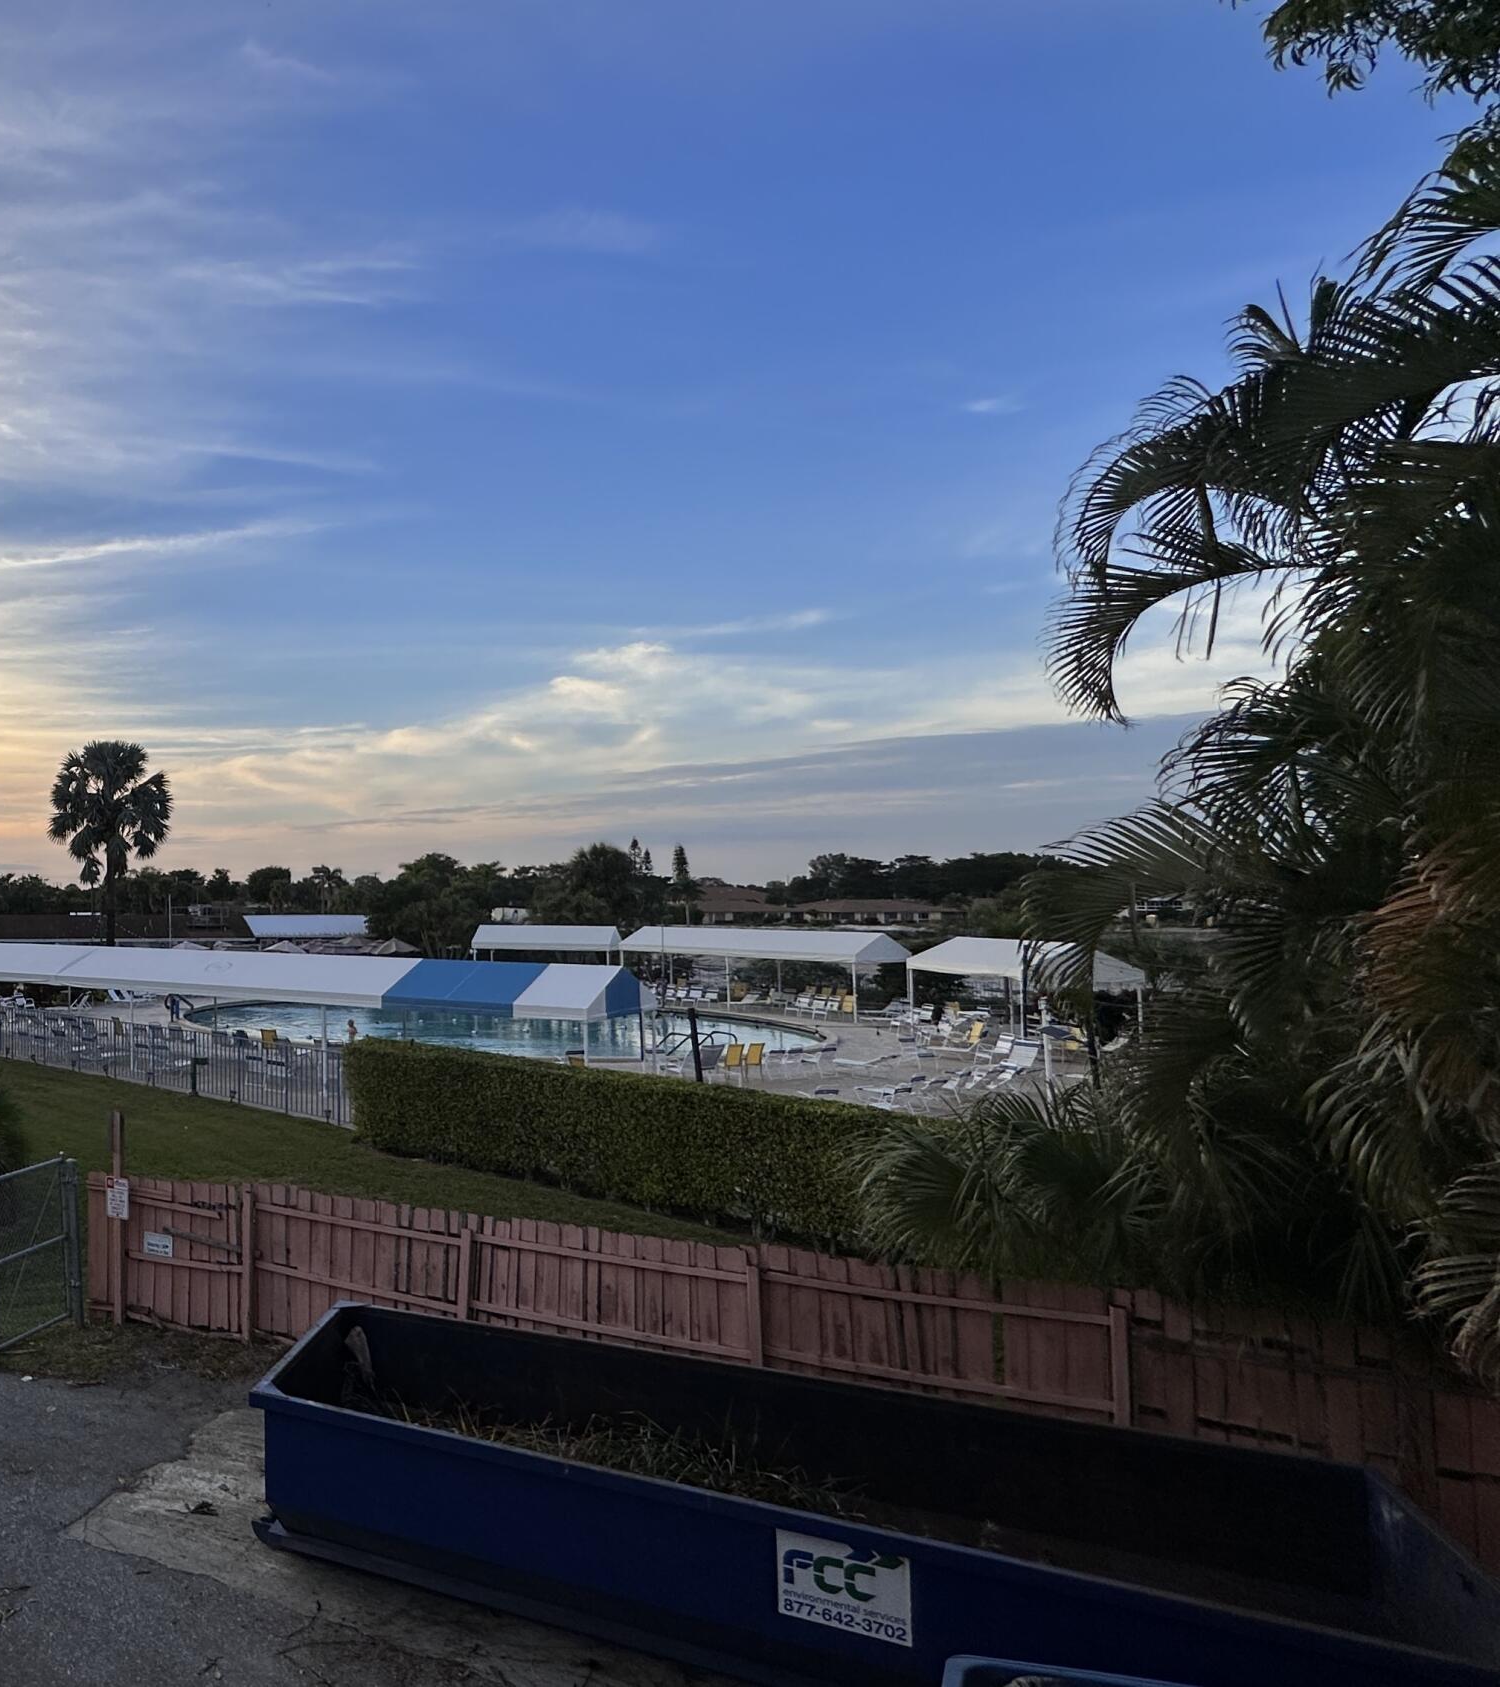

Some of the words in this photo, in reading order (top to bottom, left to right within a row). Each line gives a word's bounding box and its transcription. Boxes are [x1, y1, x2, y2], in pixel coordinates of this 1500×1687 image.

[783, 1549, 877, 1602] FCC
[783, 1589, 861, 1614] environmental
[863, 1608, 907, 1626] services
[783, 1598, 908, 1641] 877-642-3702
